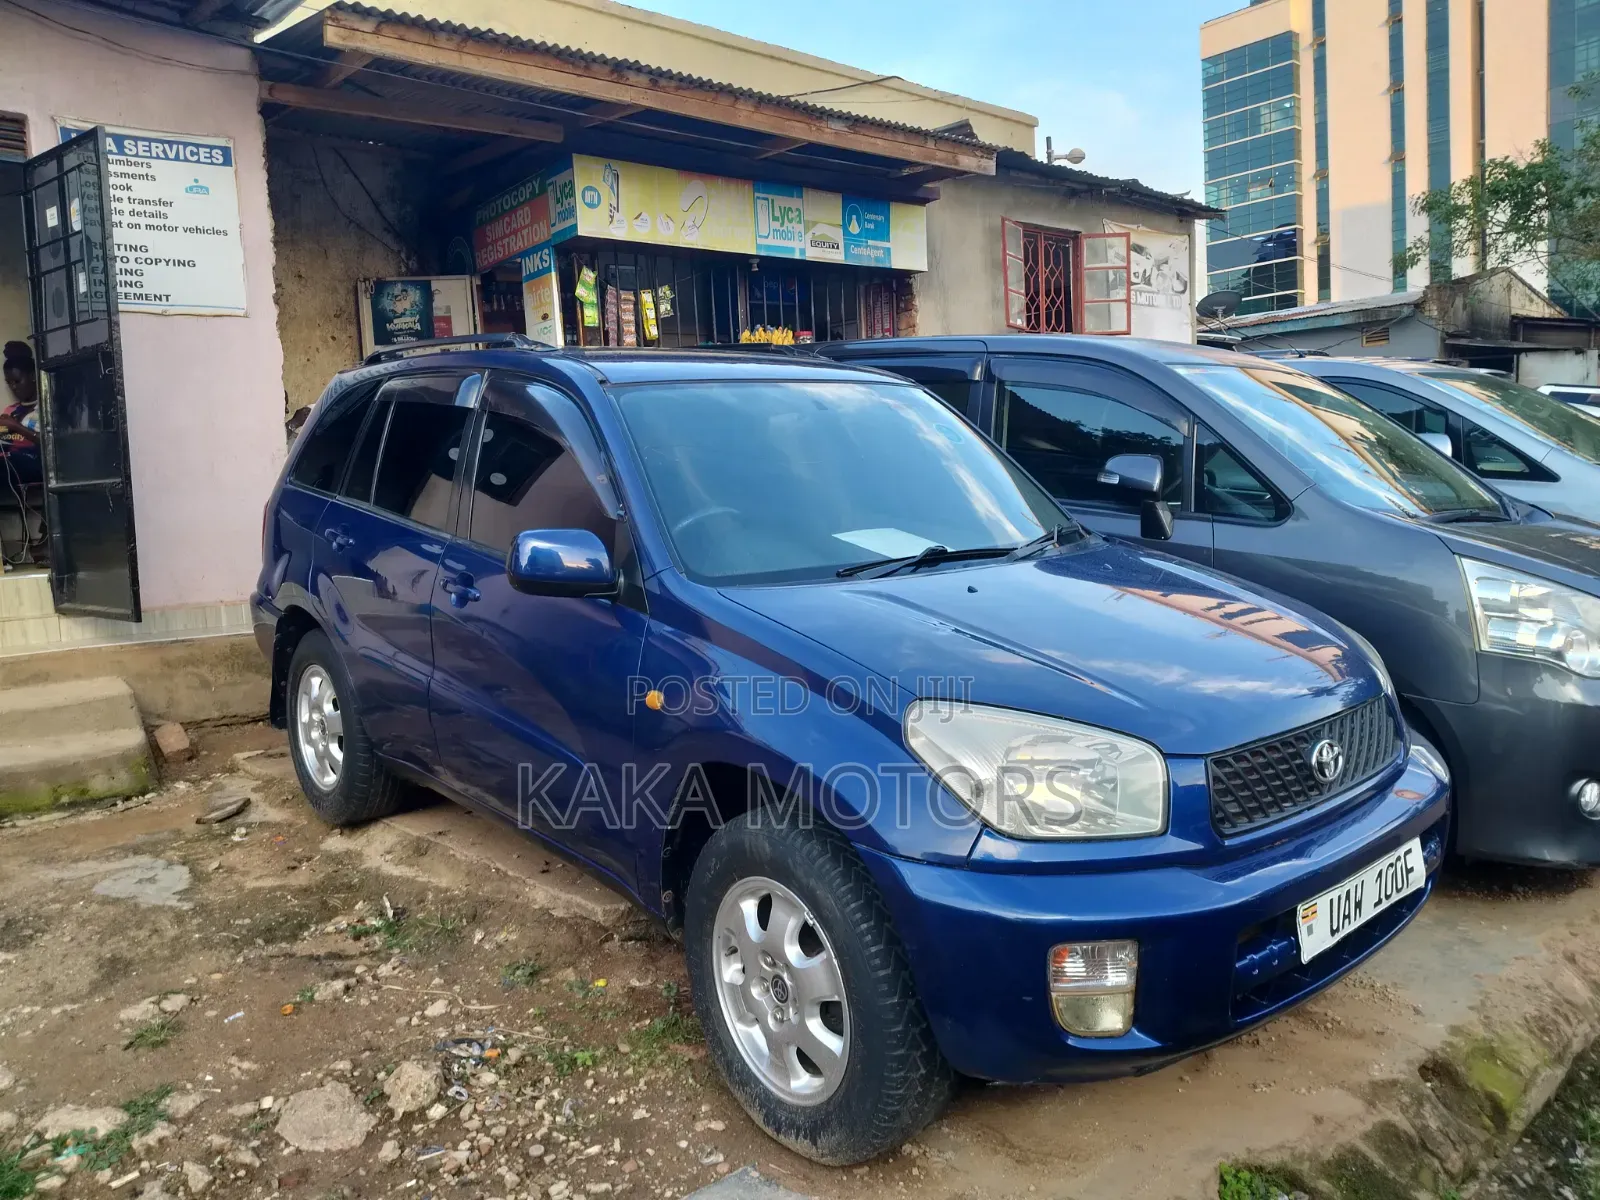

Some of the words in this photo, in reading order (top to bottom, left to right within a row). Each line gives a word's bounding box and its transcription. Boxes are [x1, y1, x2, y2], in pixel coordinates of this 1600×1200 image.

[123, 139, 224, 164] SERVICES
[106, 158, 152, 169] umbers
[108, 183, 133, 192] ook
[555, 179, 574, 208] Lyca
[127, 196, 174, 208] transfer
[476, 177, 541, 225] PHOTOCOPY
[584, 190, 598, 205] MTN
[128, 208, 169, 220] details
[771, 198, 802, 228] Lyca
[127, 221, 141, 230] on
[145, 222, 179, 233] motor
[182, 226, 228, 237] vehicles
[772, 224, 803, 242] mobie
[475, 219, 548, 270] REGISTRATION
[811, 241, 839, 250] EQUITY
[134, 256, 197, 268] COPYING
[521, 248, 550, 277] INKS
[1329, 879, 1364, 938] UAW
[1373, 847, 1415, 910] 100F
